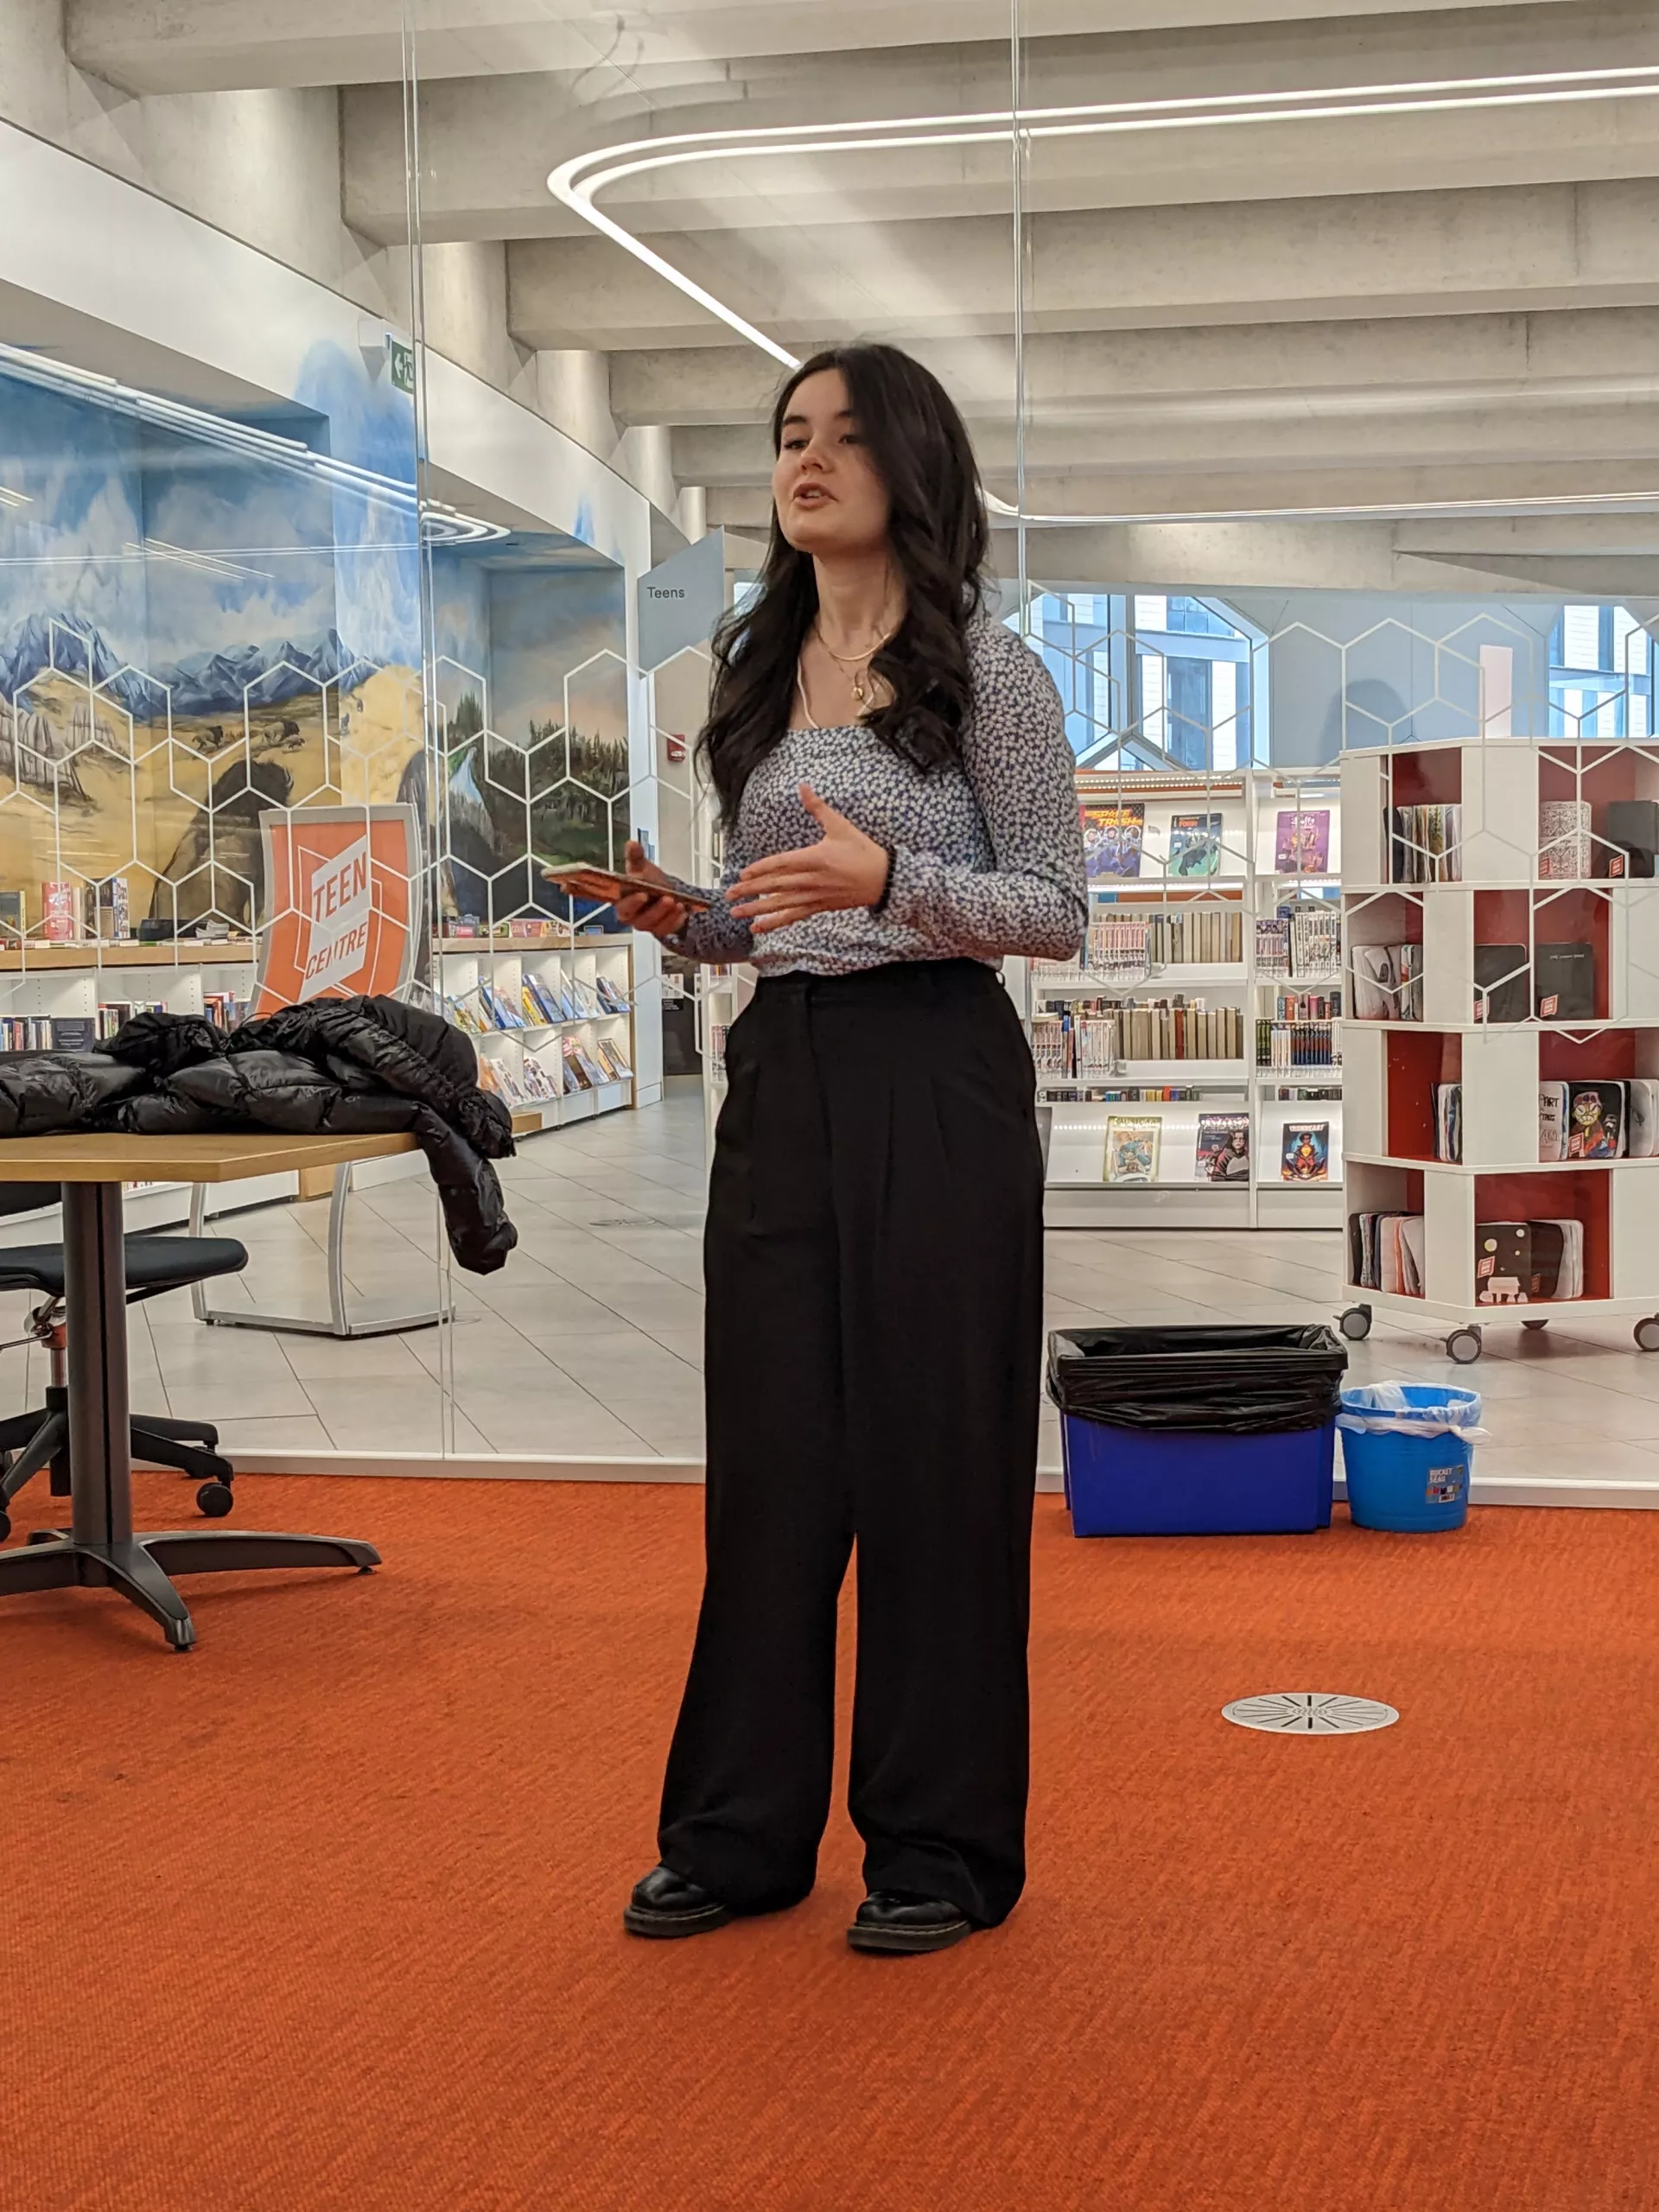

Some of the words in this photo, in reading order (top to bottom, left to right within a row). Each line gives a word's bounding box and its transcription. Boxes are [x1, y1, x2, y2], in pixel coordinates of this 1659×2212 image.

[646, 587, 685, 599] Teens
[313, 851, 366, 923] TEEN
[305, 921, 367, 980] CENTRE
